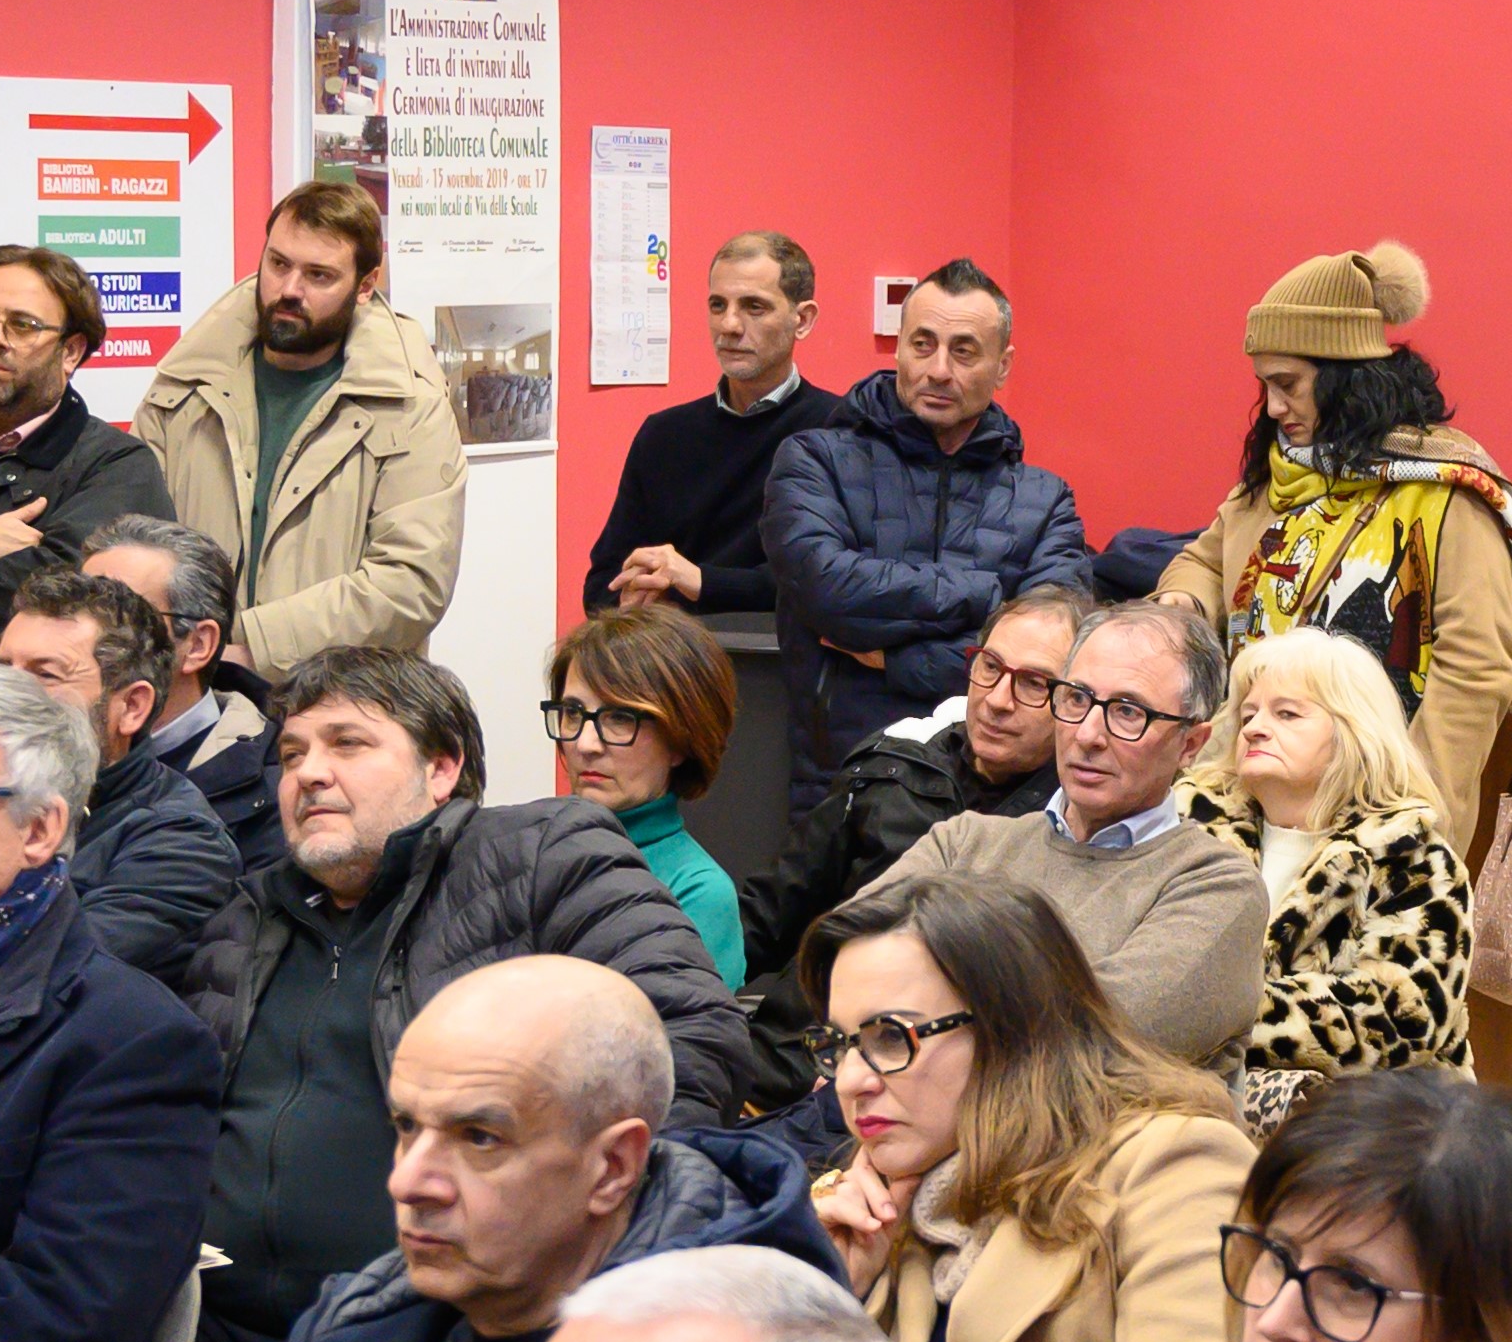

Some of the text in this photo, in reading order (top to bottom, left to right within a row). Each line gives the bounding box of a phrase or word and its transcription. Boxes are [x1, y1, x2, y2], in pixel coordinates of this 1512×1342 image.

[416, 47, 441, 77] lieta
[445, 48, 456, 77] di
[460, 48, 506, 79] invitarvi
[510, 50, 531, 79] alla
[455, 87, 465, 116] di
[469, 88, 545, 124] inaugurazione
[391, 127, 418, 157] della
[423, 125, 486, 158] Biblioteca
[42, 163, 94, 175] BIBLIOTECA
[432, 167, 443, 188] 15
[446, 167, 484, 188] novembre
[486, 168, 508, 188] 2019
[535, 168, 548, 188] 17
[43, 177, 100, 194] BAMBINI
[111, 178, 168, 195] RAGAZZI
[440, 195, 462, 216] locali
[464, 195, 472, 216] di
[475, 196, 488, 216] Via
[490, 196, 507, 216] delle
[511, 195, 538, 216] Scuole
[45, 228, 146, 245] BIBLIOTECA ADULTI
[101, 274, 141, 291] STUDI
[101, 293, 178, 311] AURICELLA"
[104, 340, 152, 357] DONNA
